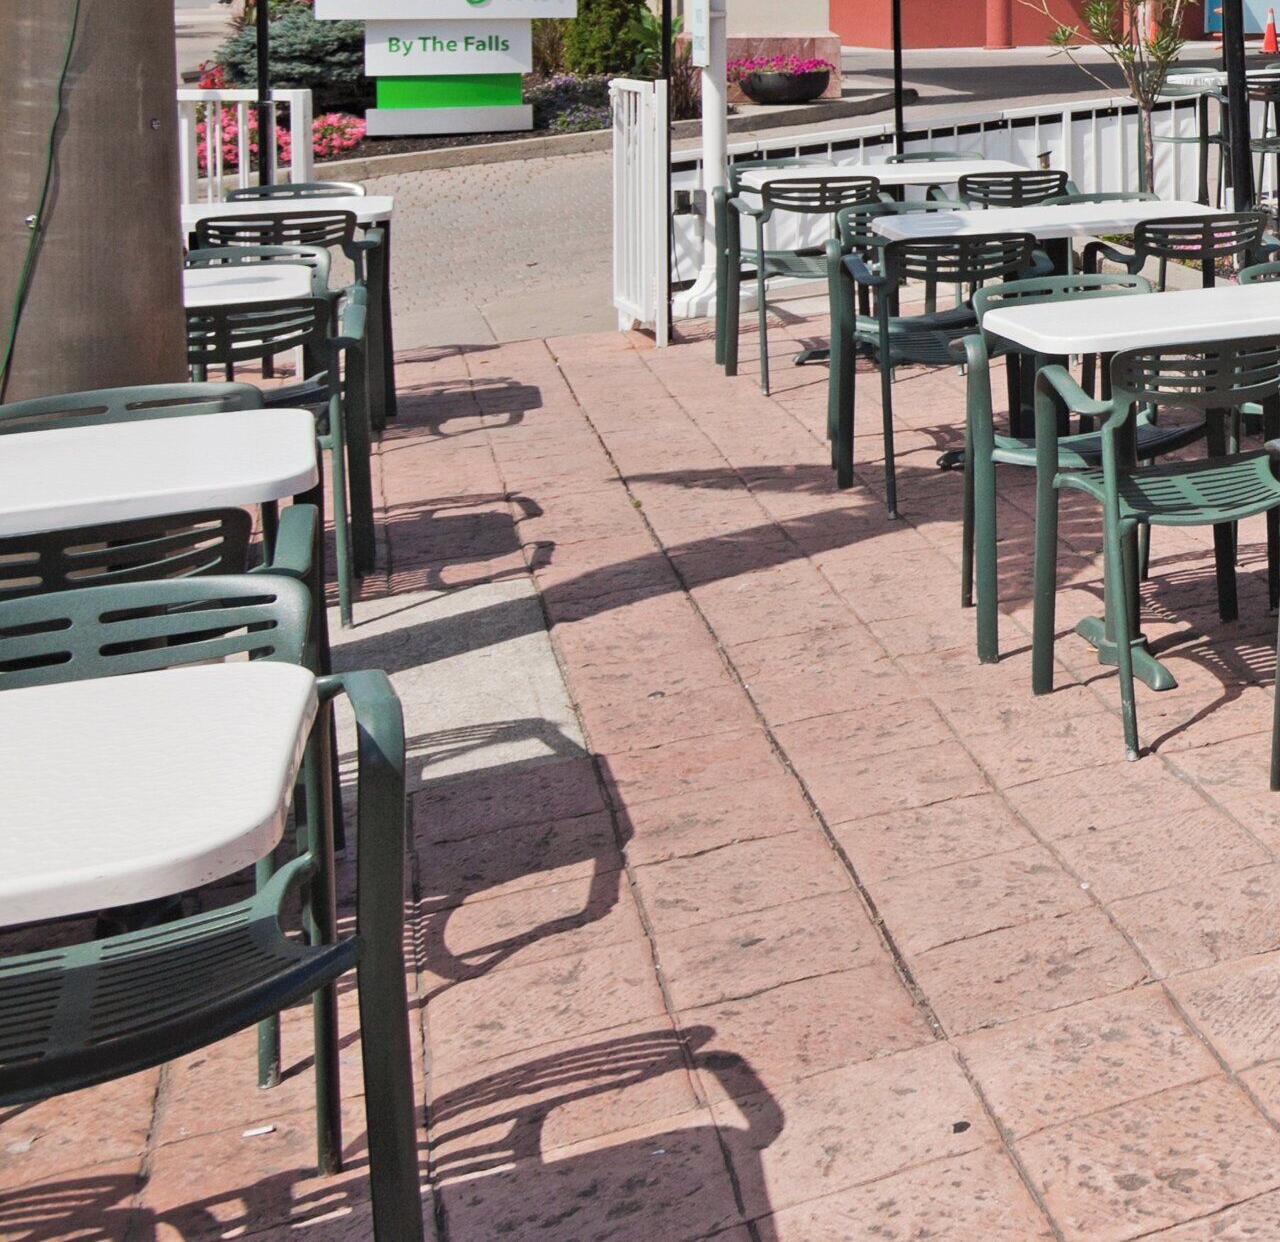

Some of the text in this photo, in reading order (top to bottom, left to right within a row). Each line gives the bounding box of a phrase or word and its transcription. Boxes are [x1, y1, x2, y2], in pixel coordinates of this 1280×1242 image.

[388, 35, 509, 55] By The Falls
